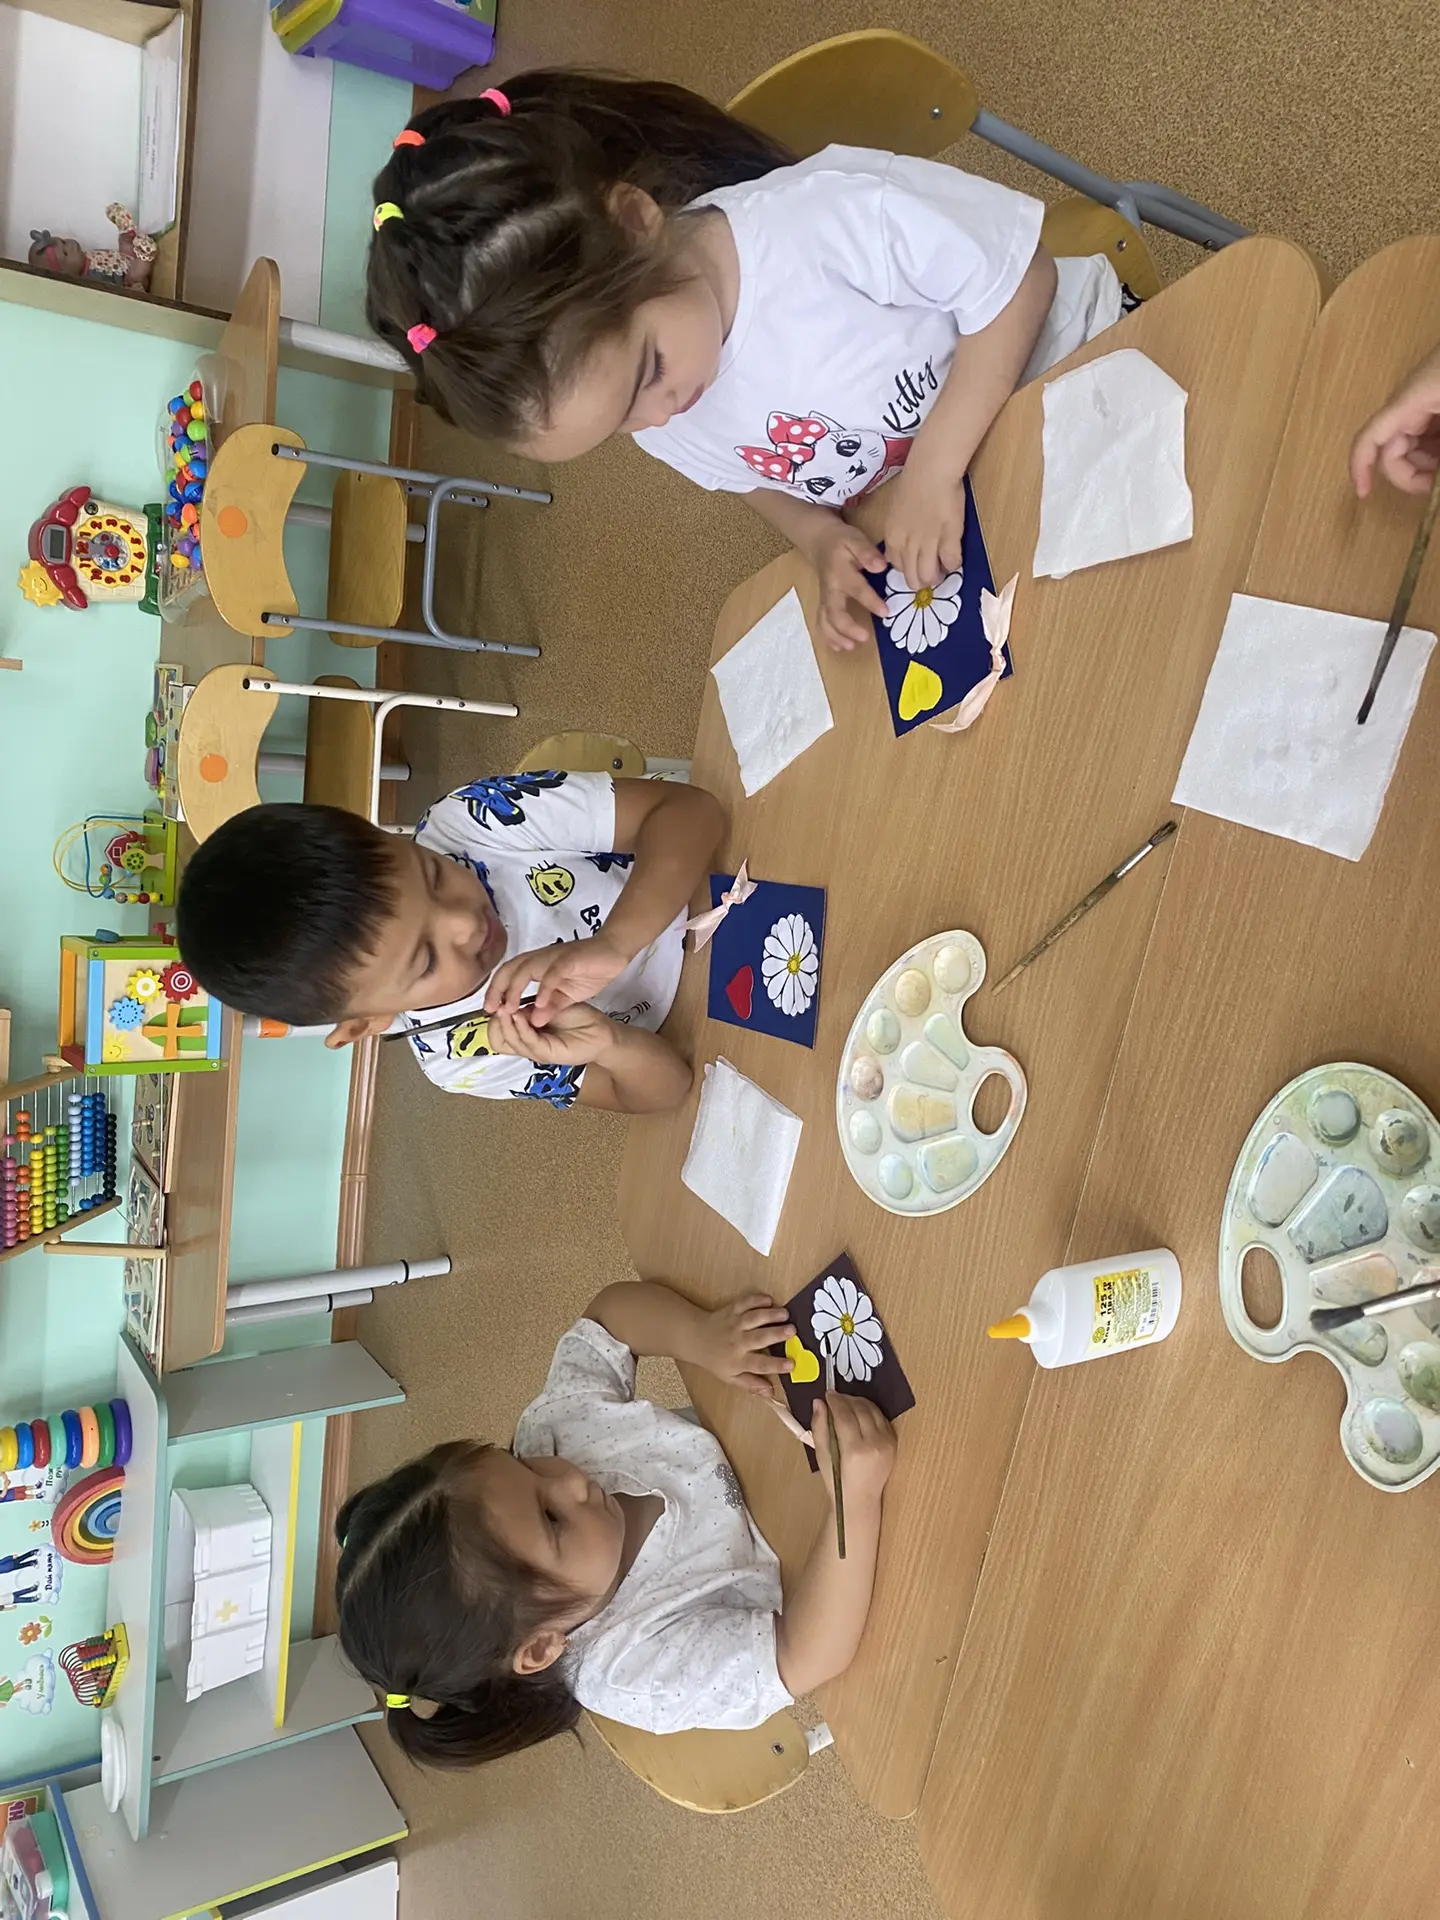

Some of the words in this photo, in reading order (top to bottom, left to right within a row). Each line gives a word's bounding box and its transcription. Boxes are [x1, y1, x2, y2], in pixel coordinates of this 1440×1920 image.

[882, 355, 938, 434] Kitty
[91, 520, 102, 530] 2
[106, 519, 118, 527] 3
[120, 525, 131, 534] 4
[131, 537, 142, 545] 5
[77, 541, 88, 554] 12
[79, 557, 91, 568] 11
[131, 565, 142, 573] 7
[90, 568, 102, 581] 10
[120, 575, 131, 583] 8
[105, 576, 116, 584] 9
[1103, 1281, 1108, 1291] гр
[1102, 1320, 1111, 1344] Клей
[44, 1574, 52, 1591] Дай
[8, 1801, 26, 1821] НЬ
